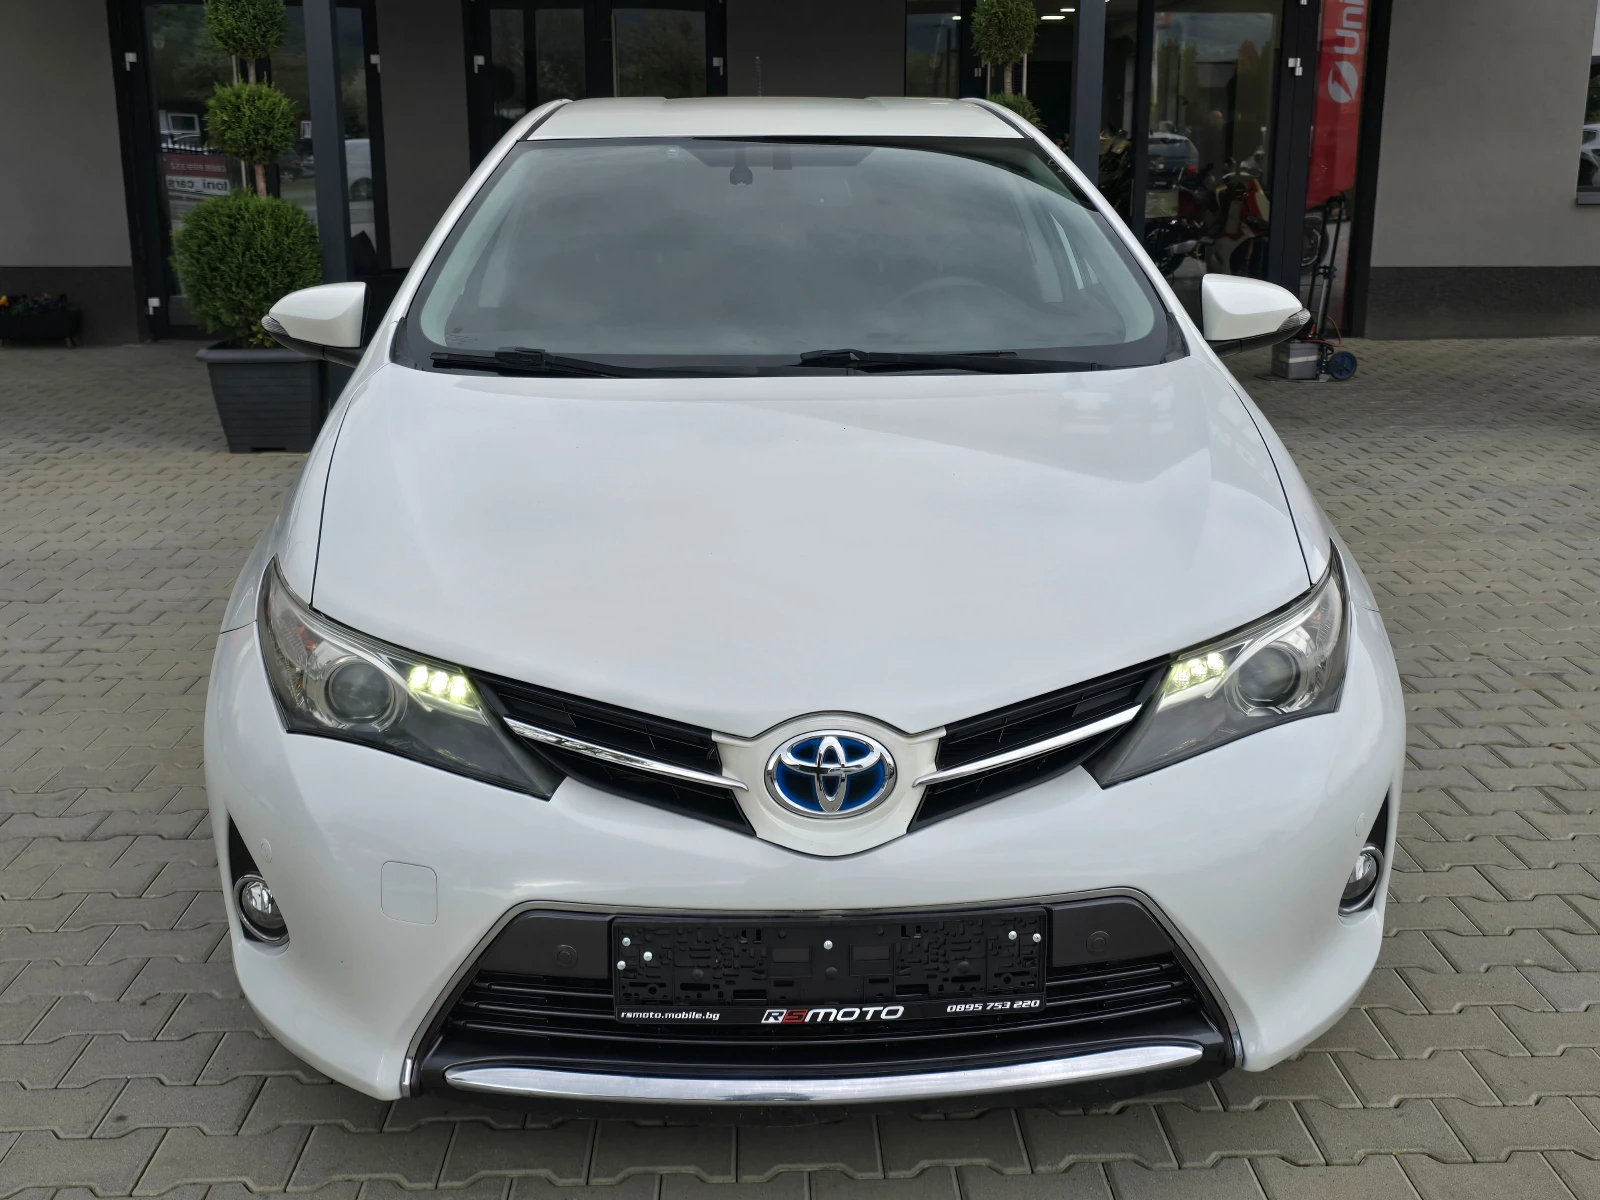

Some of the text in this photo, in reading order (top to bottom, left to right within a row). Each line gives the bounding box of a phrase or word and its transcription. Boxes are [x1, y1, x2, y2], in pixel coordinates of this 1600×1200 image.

[947, 999, 1040, 1013] 0895 753 220
[621, 1011, 721, 1021] rsmoto.mobile.bg
[761, 1005, 905, 1024] RSMOTO
